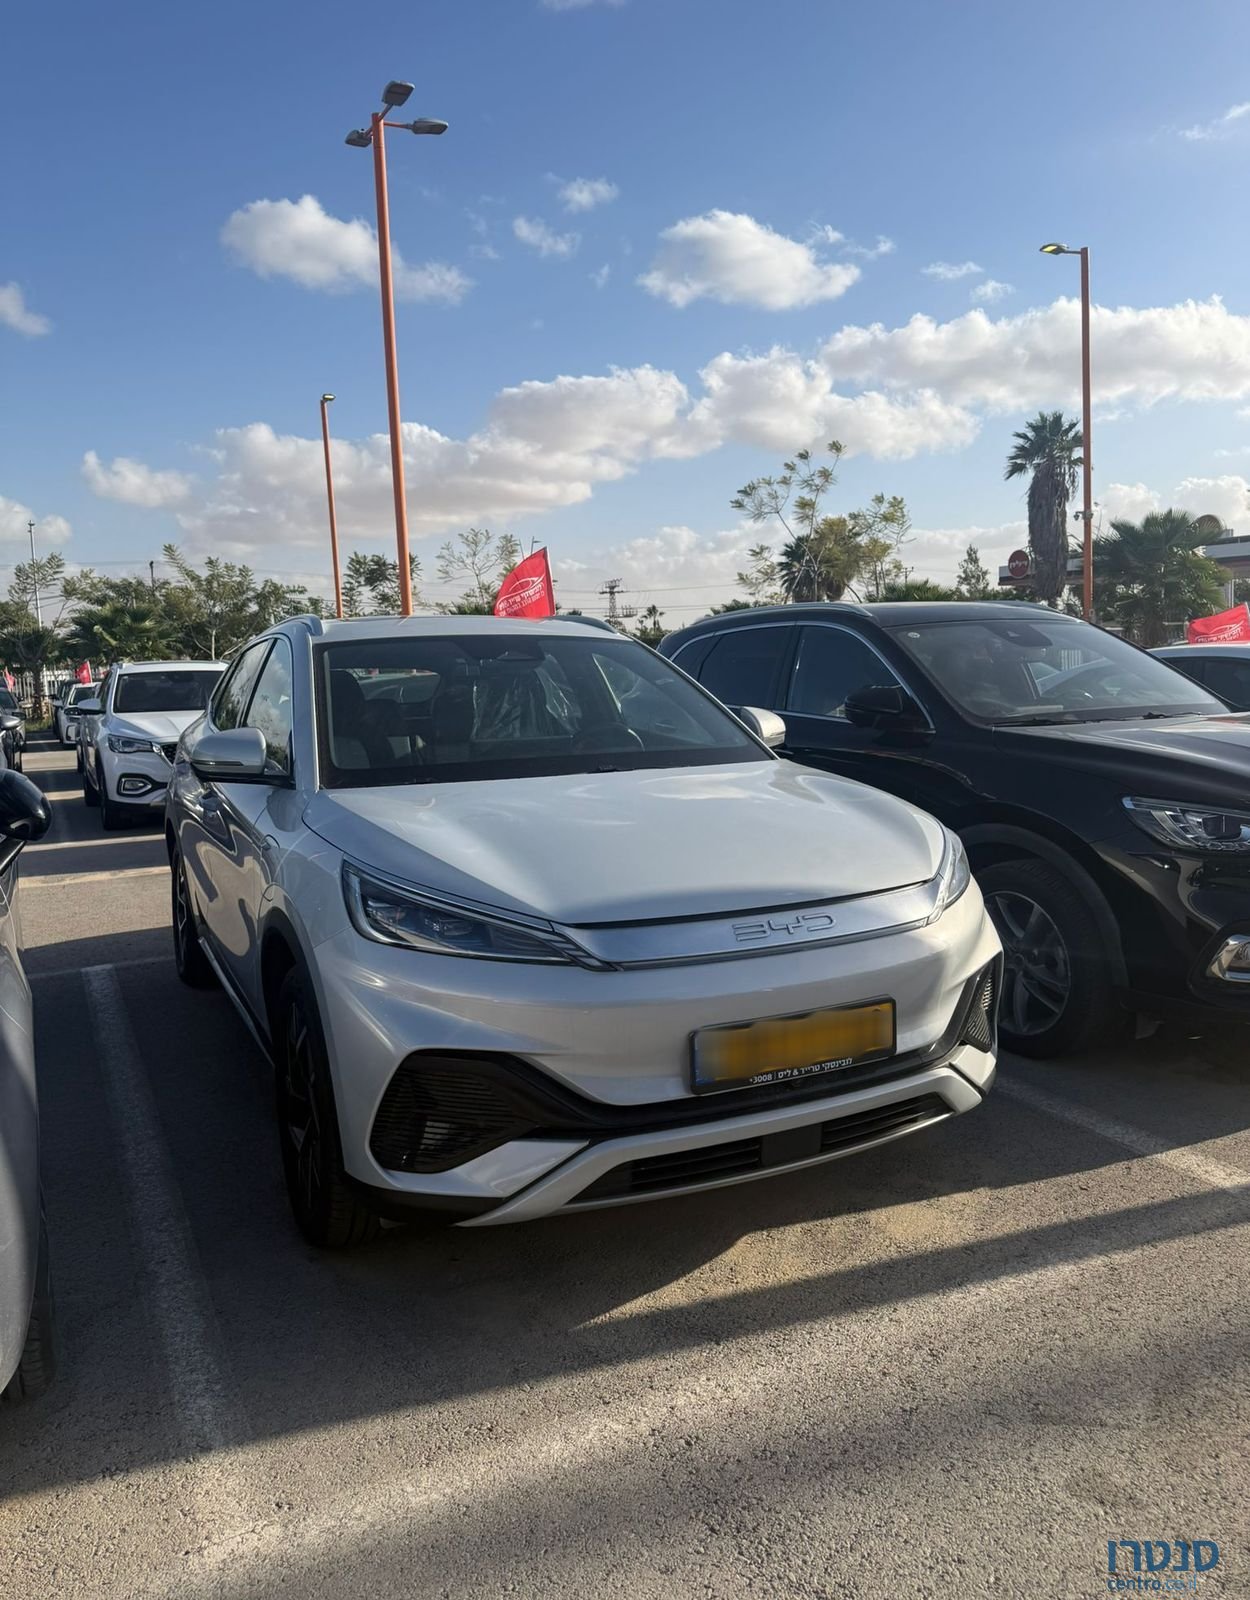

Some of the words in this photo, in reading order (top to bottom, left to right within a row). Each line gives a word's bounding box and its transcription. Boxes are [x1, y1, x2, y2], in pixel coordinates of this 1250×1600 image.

[731, 912, 836, 942] BYD
[822, 1057, 853, 1071] לובינסקי
[778, 1069, 792, 1079] ליס
